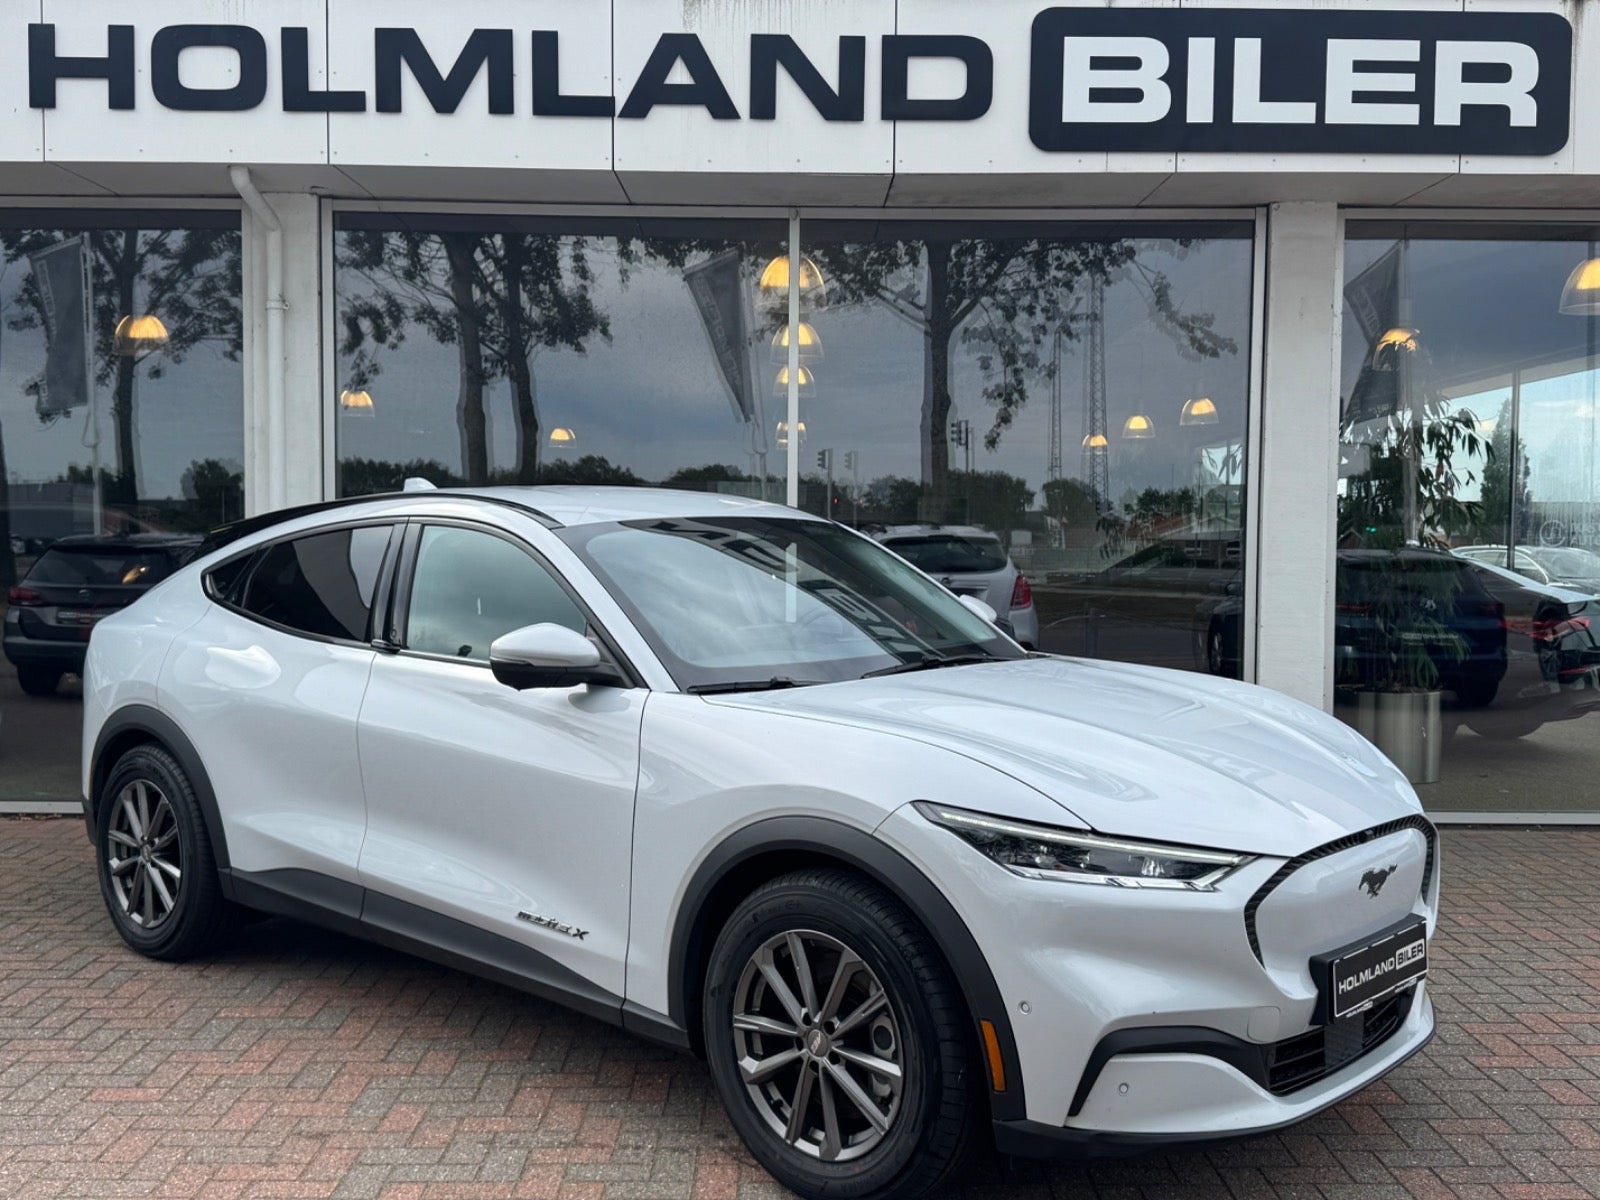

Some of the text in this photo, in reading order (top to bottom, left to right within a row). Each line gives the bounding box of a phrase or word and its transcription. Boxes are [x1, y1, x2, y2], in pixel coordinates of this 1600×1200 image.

[28, 23, 1540, 127] HOLMLAND BILER
[1338, 957, 1396, 995] HOLMLAND
[1396, 942, 1425, 966] BILER
